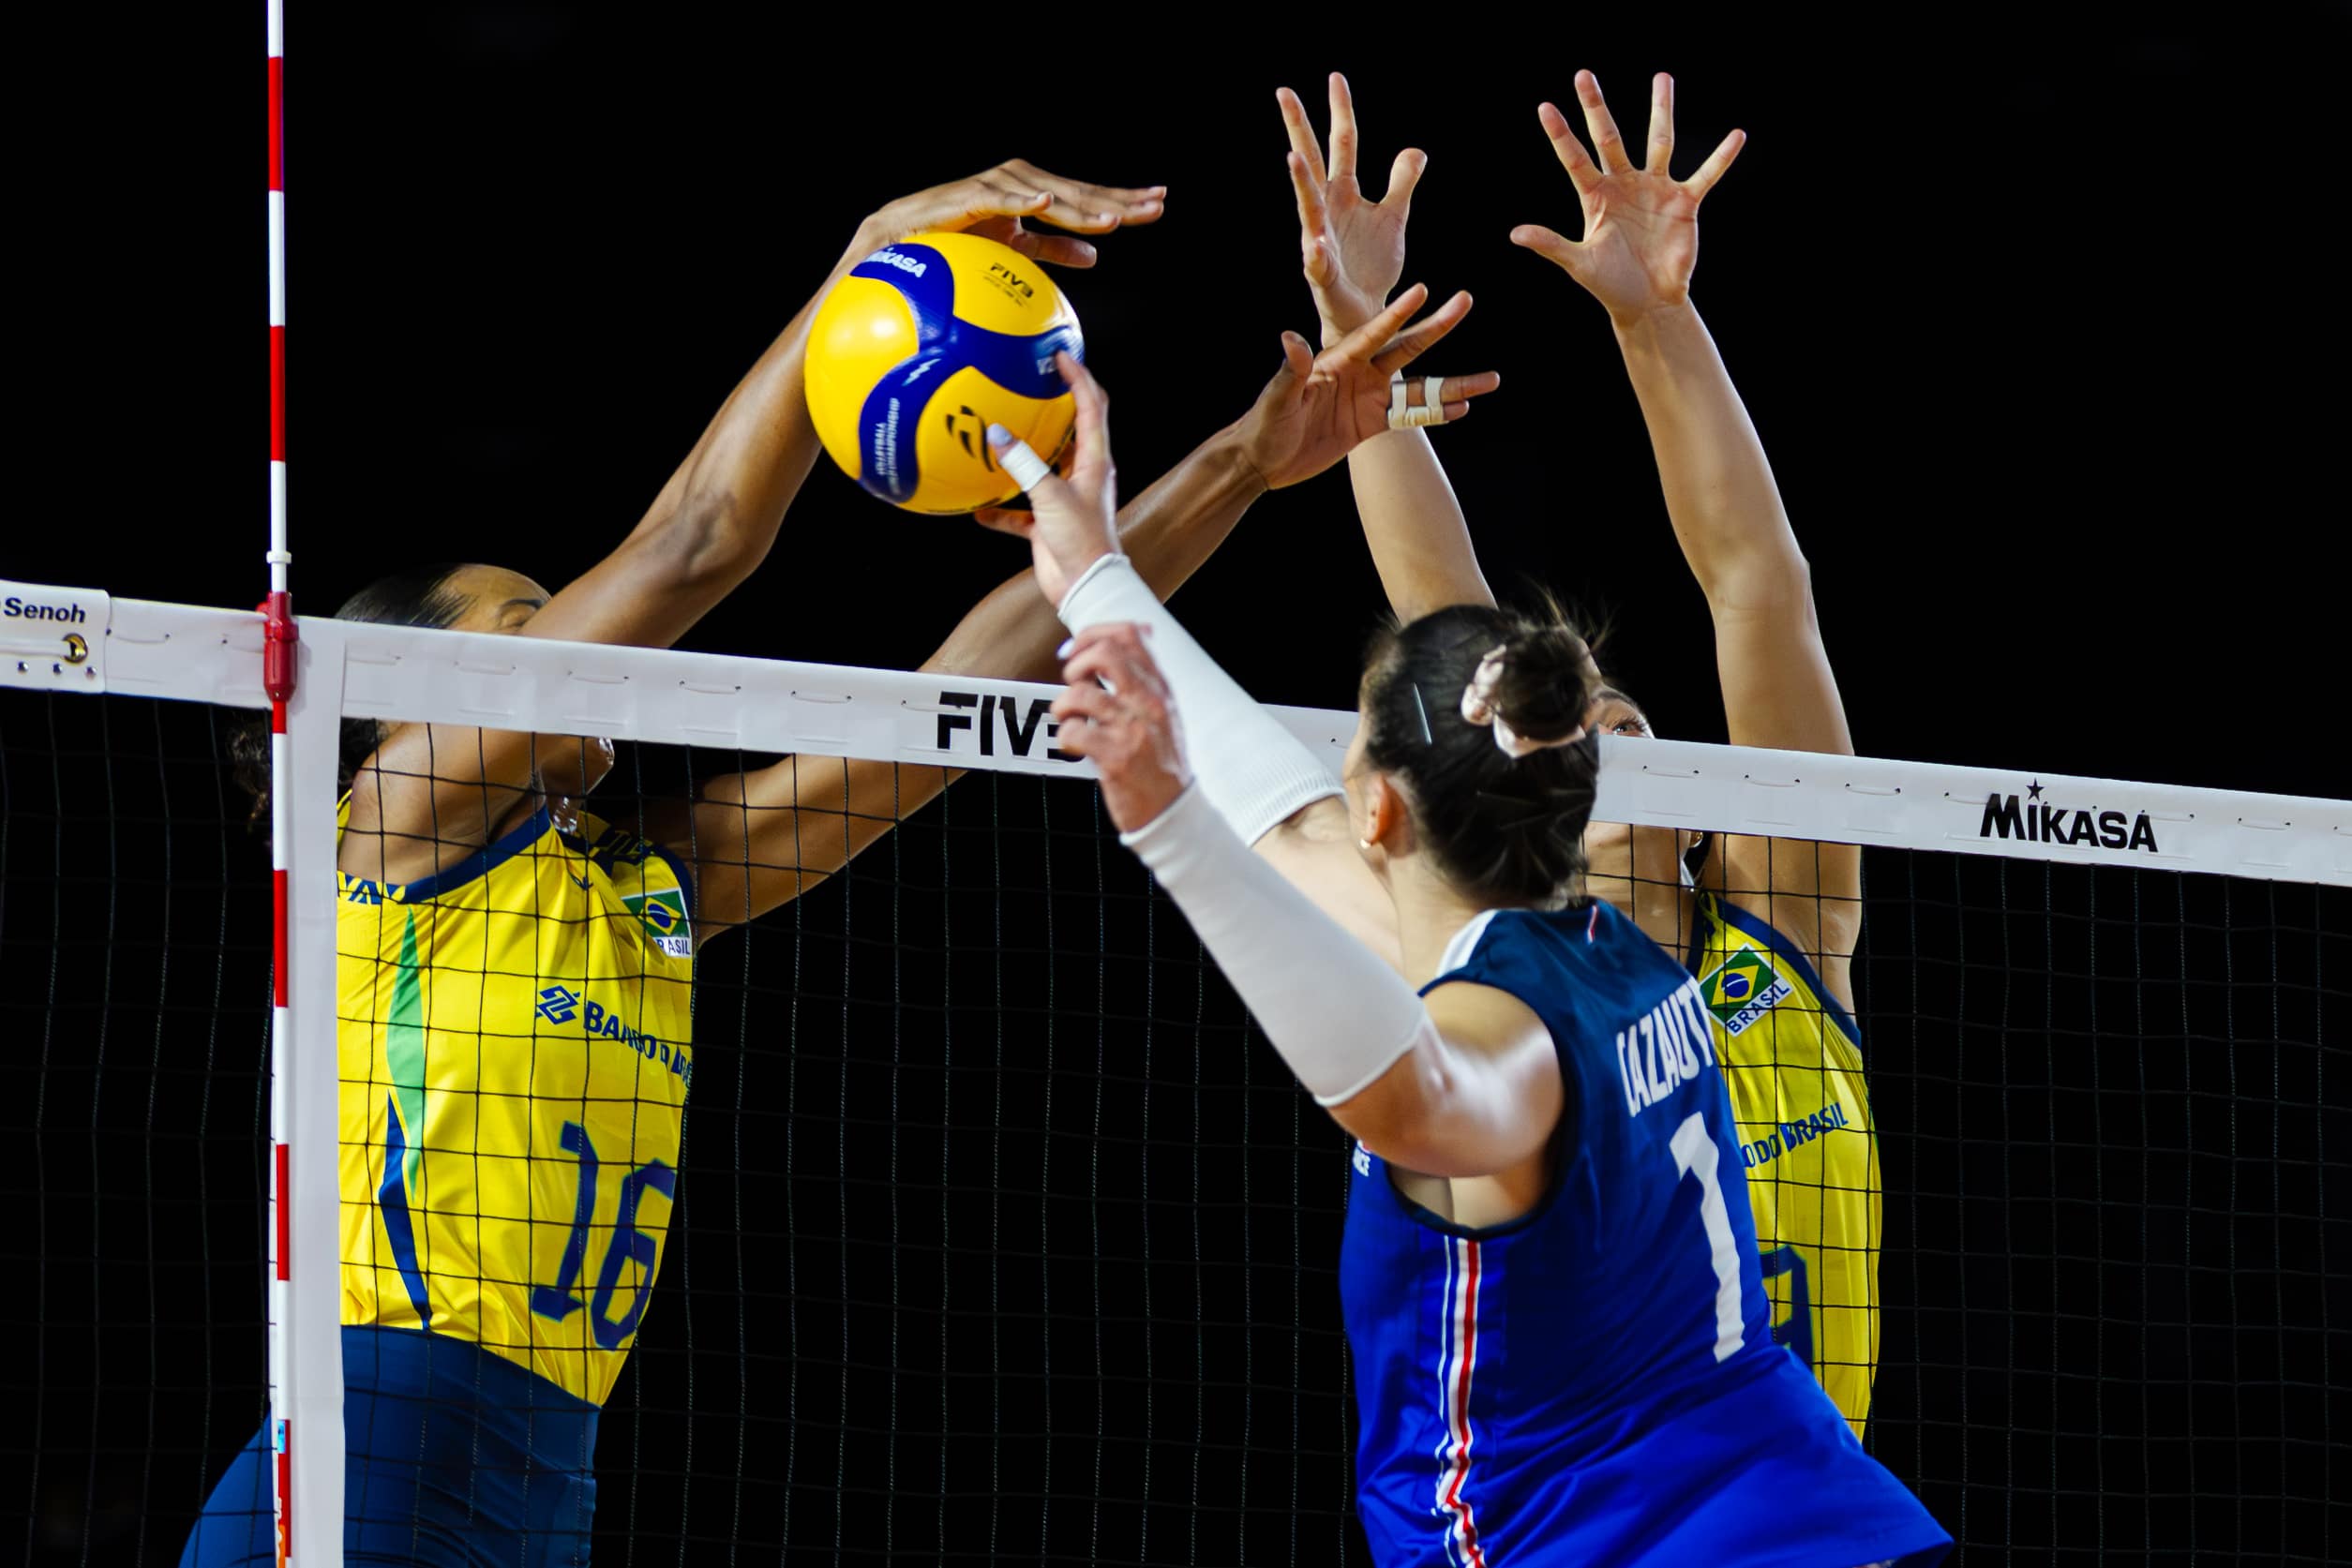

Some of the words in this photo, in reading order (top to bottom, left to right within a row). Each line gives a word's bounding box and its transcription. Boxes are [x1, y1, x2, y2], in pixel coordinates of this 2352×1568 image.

[4, 597, 85, 623] Senoh
[1980, 785, 2158, 852] MIKASA
[1727, 984, 1790, 1033] BRASIL
[1753, 1133, 1782, 1164] DO
[1779, 1101, 1849, 1153] BRASIL
[531, 1120, 677, 1351] 16
[1669, 1111, 1745, 1364] 1
